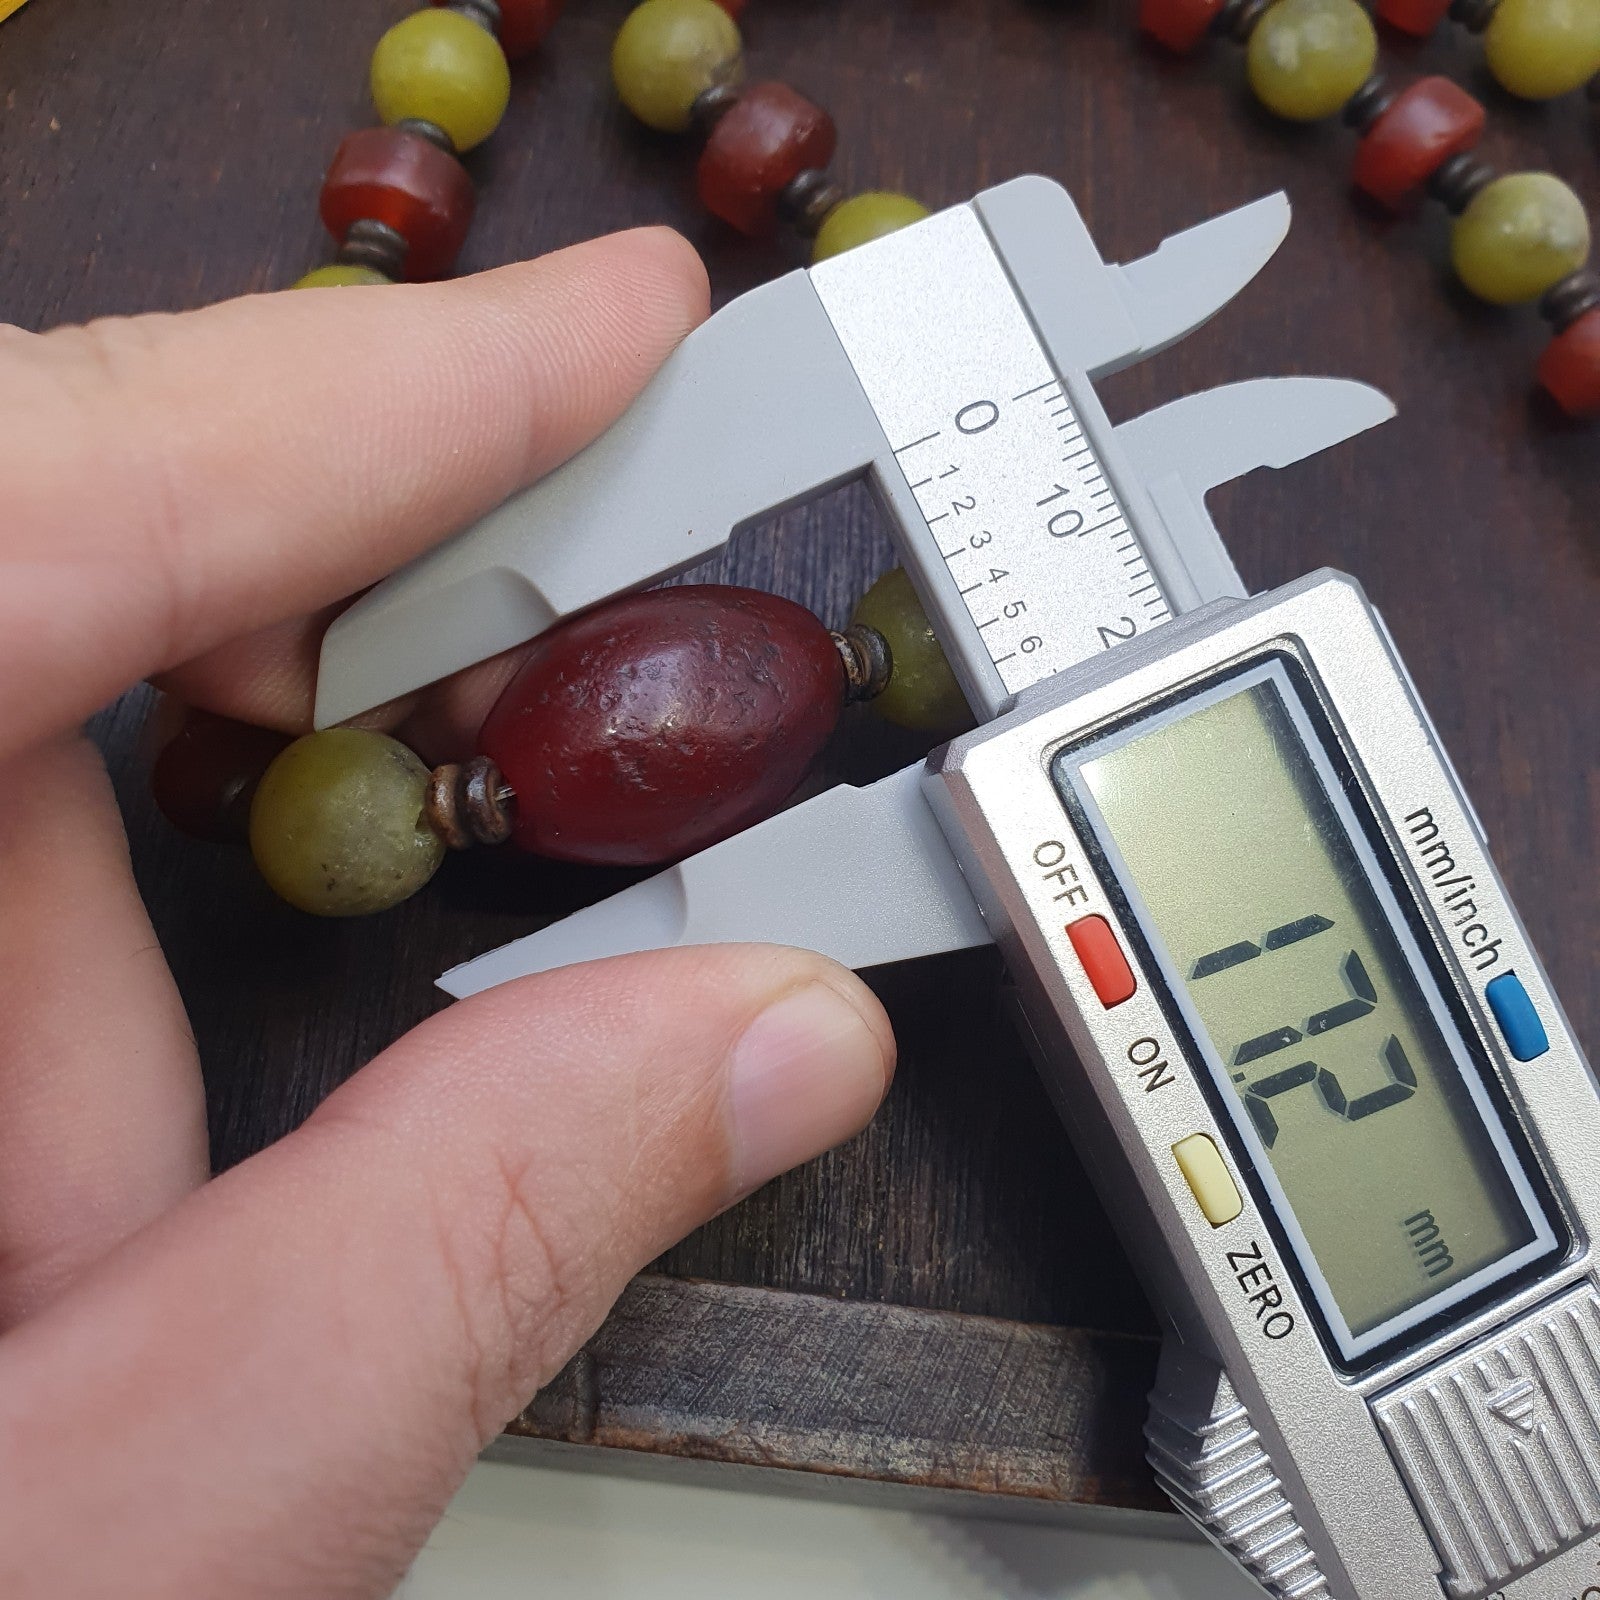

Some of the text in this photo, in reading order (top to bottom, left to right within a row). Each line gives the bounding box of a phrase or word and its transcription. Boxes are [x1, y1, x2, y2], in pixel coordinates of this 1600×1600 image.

[955, 400, 999, 434] 0
[1036, 484, 1084, 538] 10
[939, 464, 1043, 654] 1 2 3 4 5 6
[1033, 840, 1089, 907] OFF
[1404, 806, 1502, 970] mm/inch
[1127, 1036, 1176, 1093] ON
[1227, 1241, 1295, 1340] ZERO
[1404, 1208, 1454, 1278] mm
